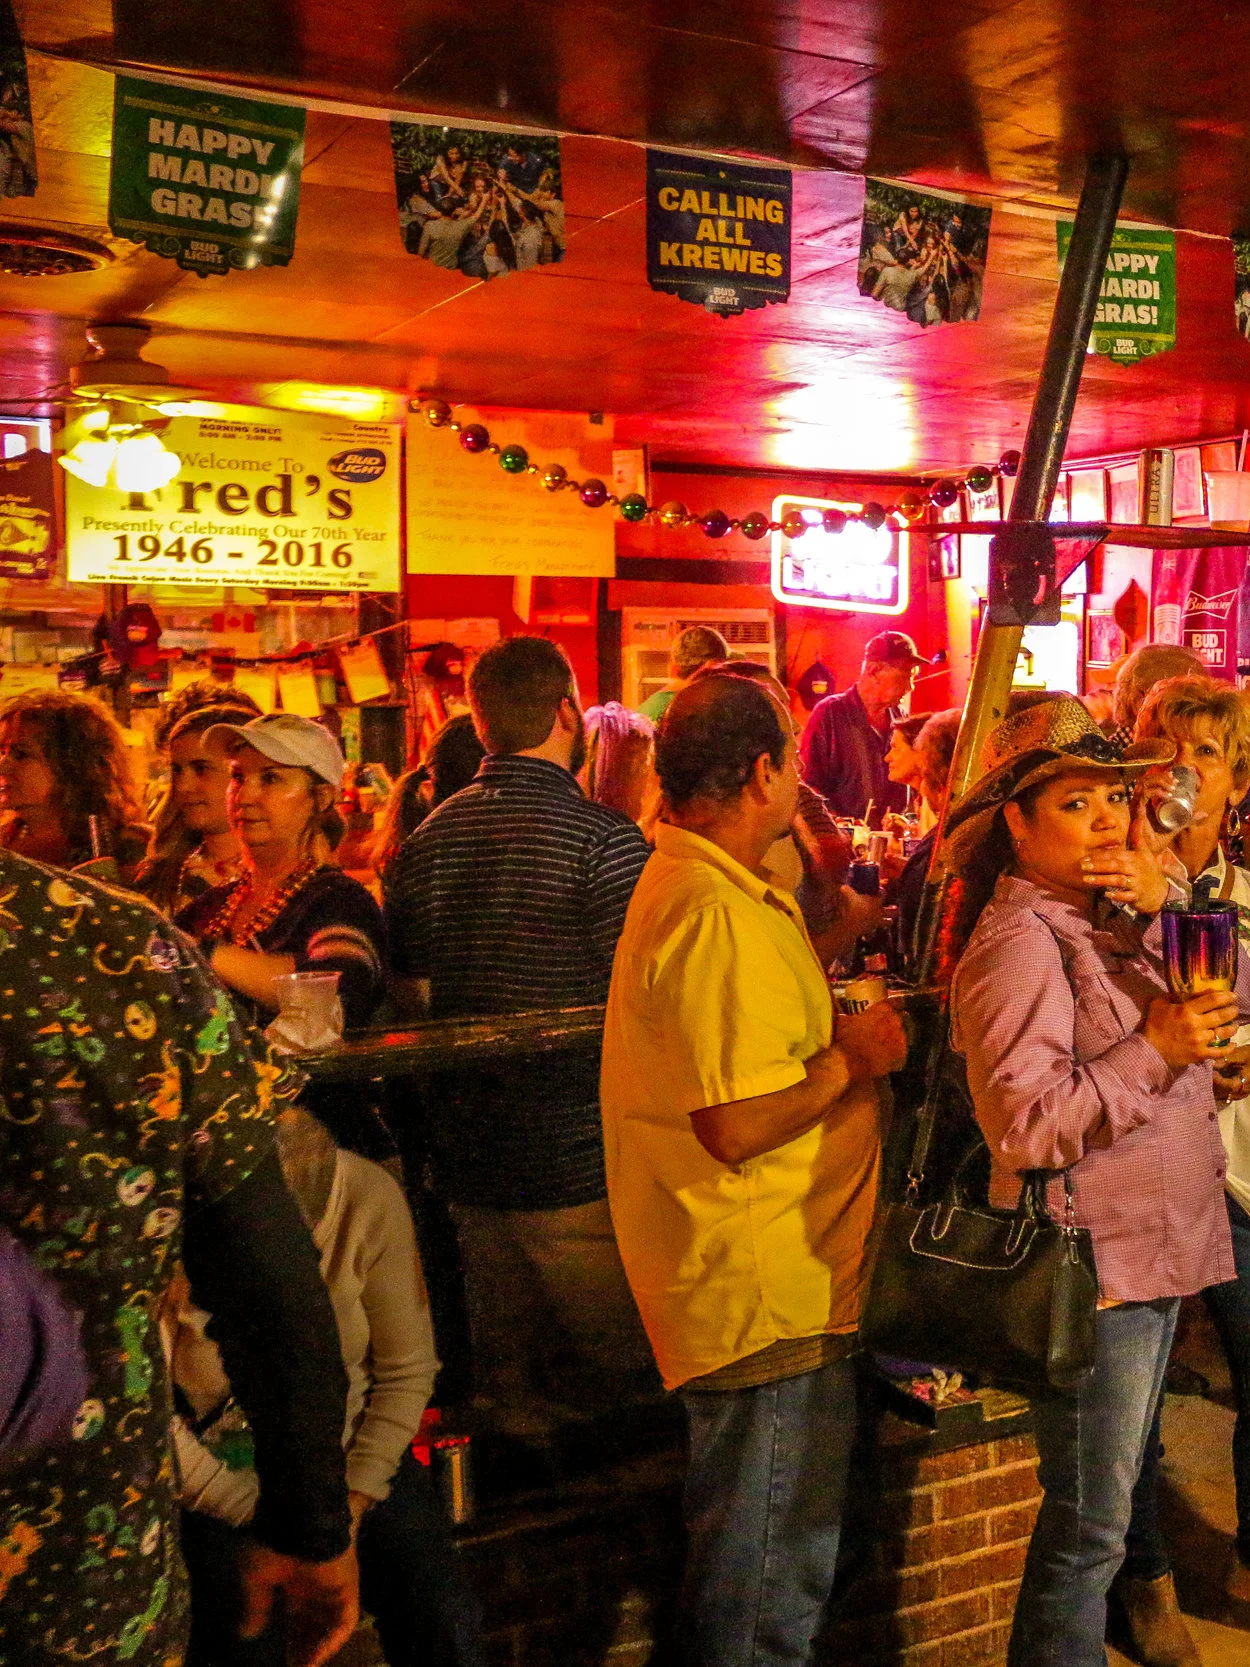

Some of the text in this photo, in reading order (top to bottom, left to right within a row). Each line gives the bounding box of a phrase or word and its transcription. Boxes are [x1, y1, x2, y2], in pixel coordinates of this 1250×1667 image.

[148, 117, 275, 165] HAPPY
[148, 152, 272, 199] MARDI
[658, 187, 784, 224] CALLING
[695, 218, 752, 246] ALL
[184, 249, 224, 264] LIGHT
[190, 240, 219, 253] BUD
[659, 241, 783, 277] KREWES
[1105, 253, 1159, 274] APPY
[708, 294, 740, 306] LIGHT
[713, 286, 736, 297] BUD
[1093, 302, 1158, 325] GRAS!
[1113, 346, 1138, 354] LIGHT
[1115, 339, 1135, 347] BUD
[179, 451, 304, 473] Welcome To
[337, 463, 385, 475] LIGHT
[344, 453, 381, 464] BUD
[1150, 466, 1161, 514] ULTRA
[82, 516, 388, 541] Presently Celebrating Our 70th Year
[113, 534, 214, 564] 1946
[257, 540, 353, 568] 2016
[1185, 594, 1231, 612] Budweiser
[1191, 633, 1219, 648] BUD
